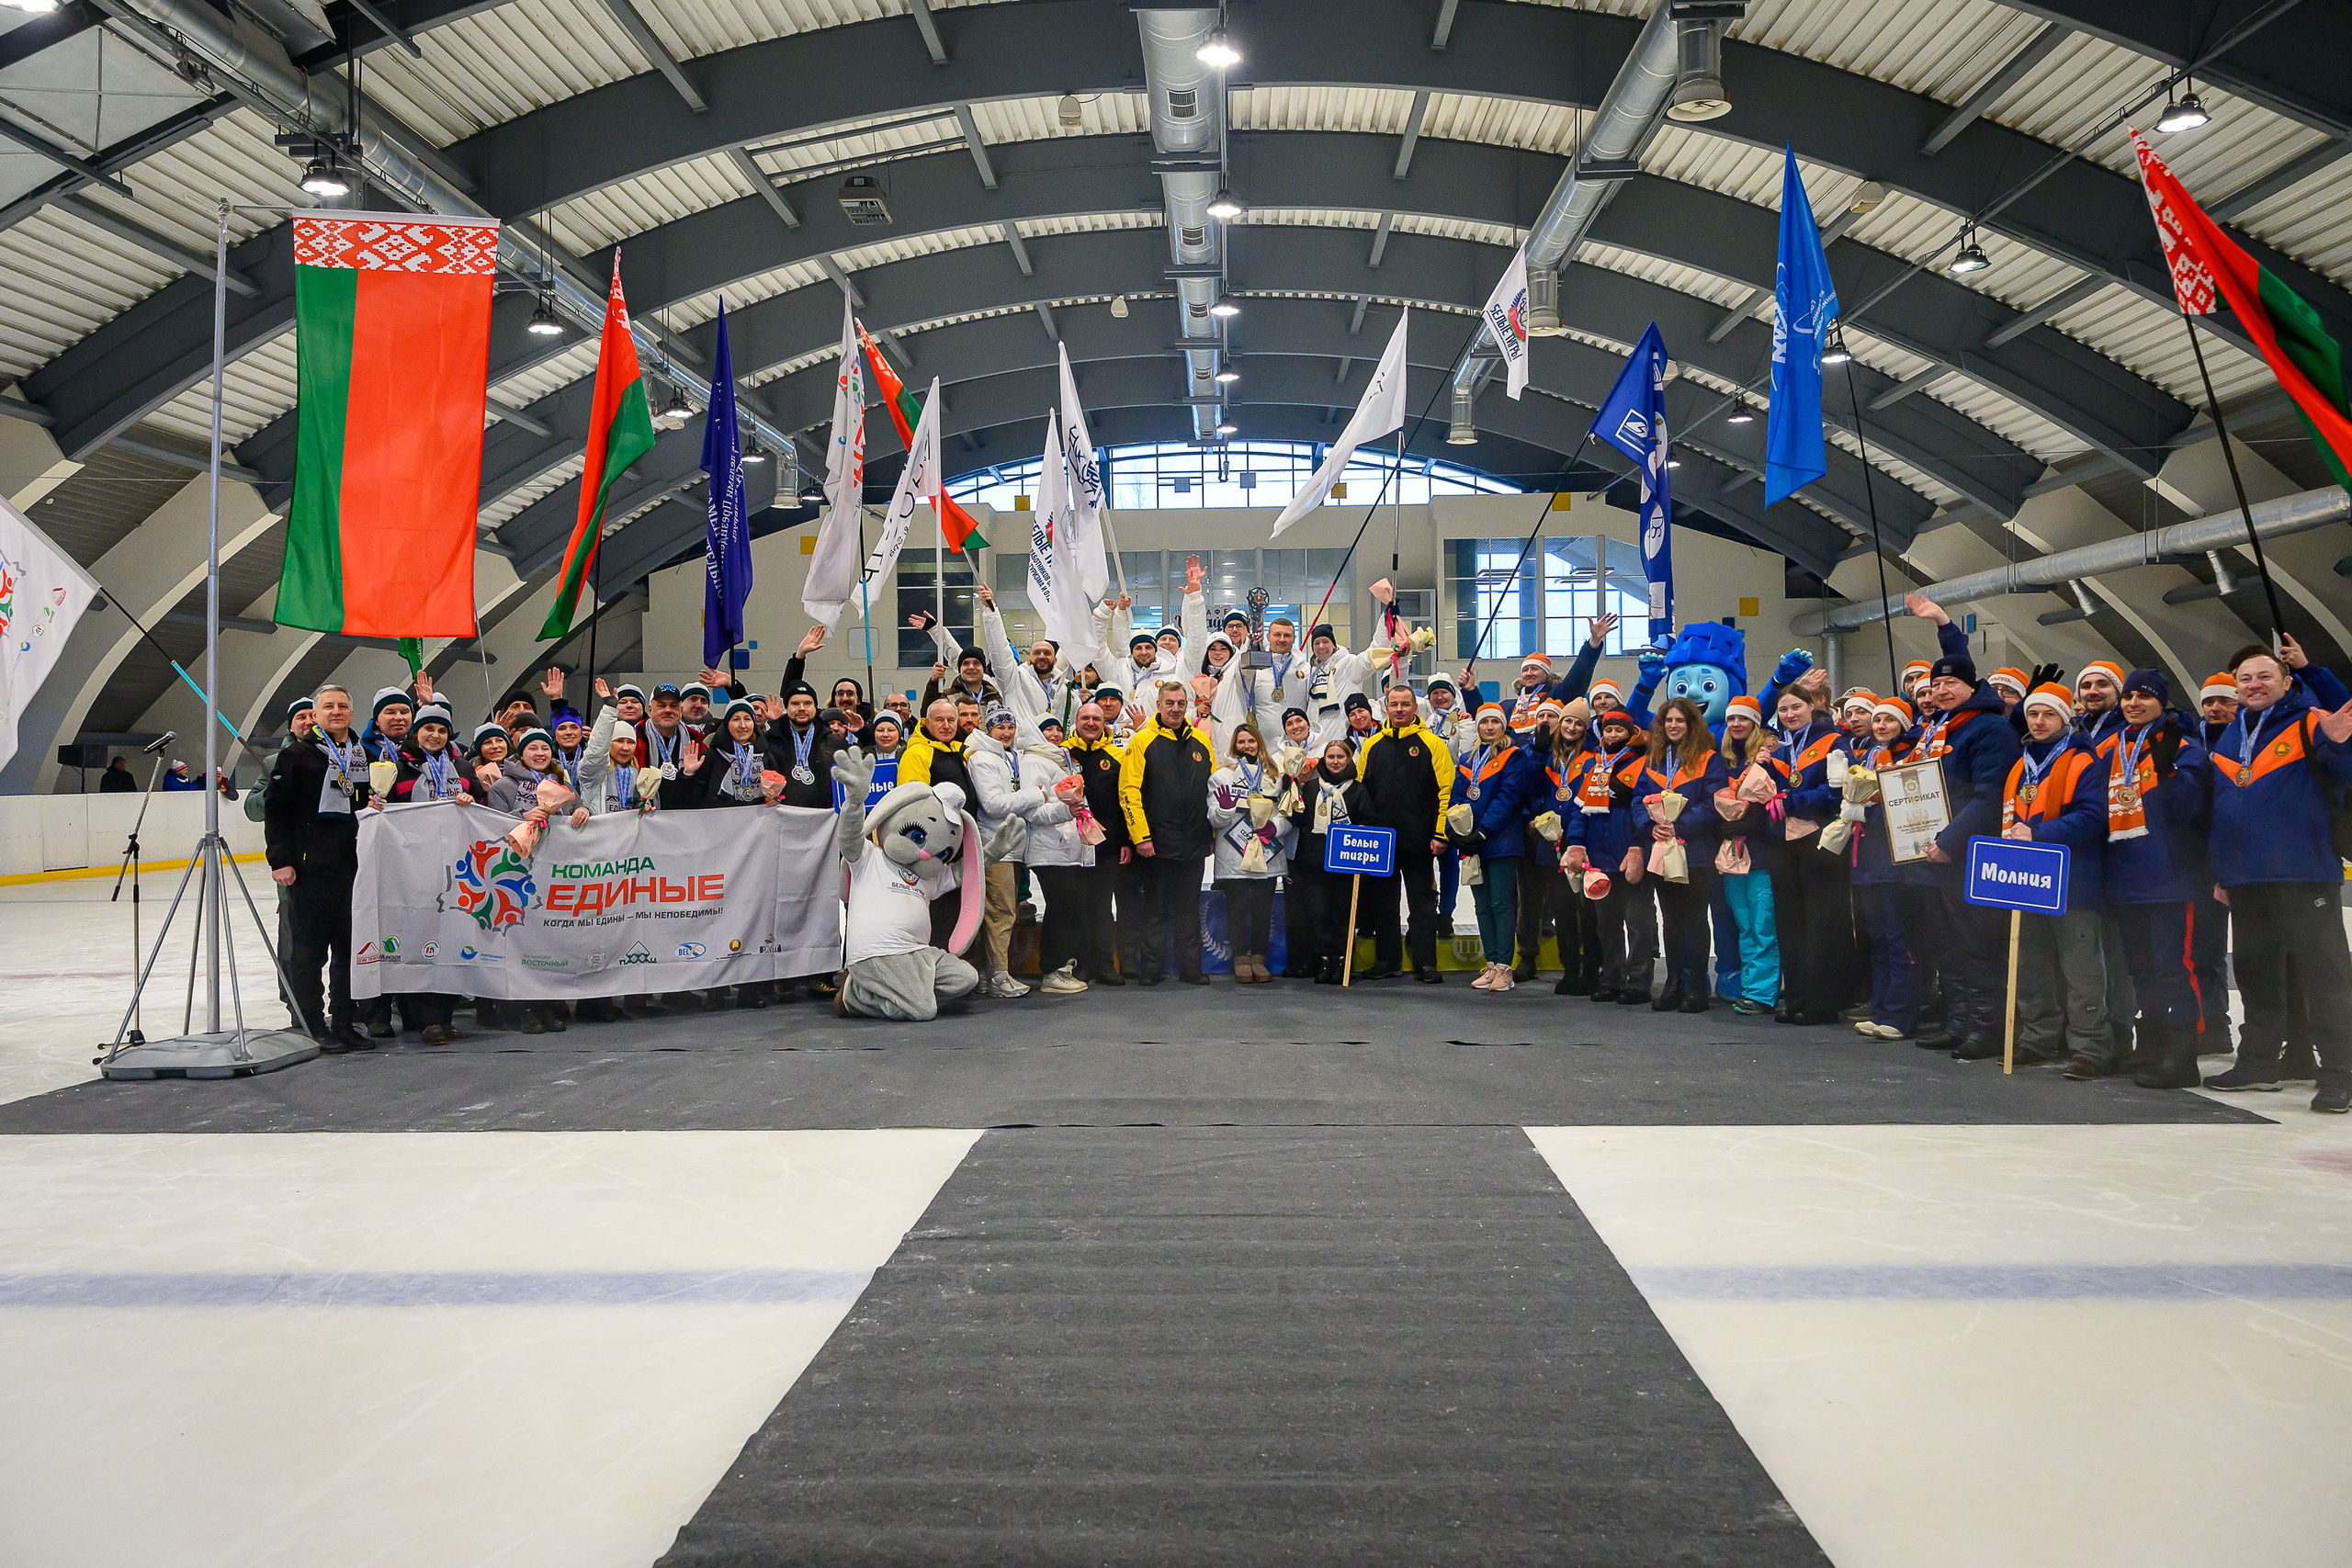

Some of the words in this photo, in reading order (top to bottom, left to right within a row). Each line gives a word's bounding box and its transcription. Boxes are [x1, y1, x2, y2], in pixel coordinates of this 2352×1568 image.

[1888, 791, 1939, 807] СЕРТИФИКАТ
[1343, 834, 1379, 849] Белые
[551, 856, 655, 879] КОМАНДА
[1340, 851, 1380, 865] тигры
[1981, 862, 2052, 889] Молния
[546, 874, 724, 918] ЕДИНЫЕ
[543, 919, 575, 929] КОГДА
[577, 919, 594, 928] МЫ
[596, 914, 625, 927] ЕДИНЫ
[635, 911, 651, 919] МЫ
[654, 907, 724, 919] НЕПОБЕДИМЫ!
[521, 959, 569, 967] ВОСТОЧНЫЙ
